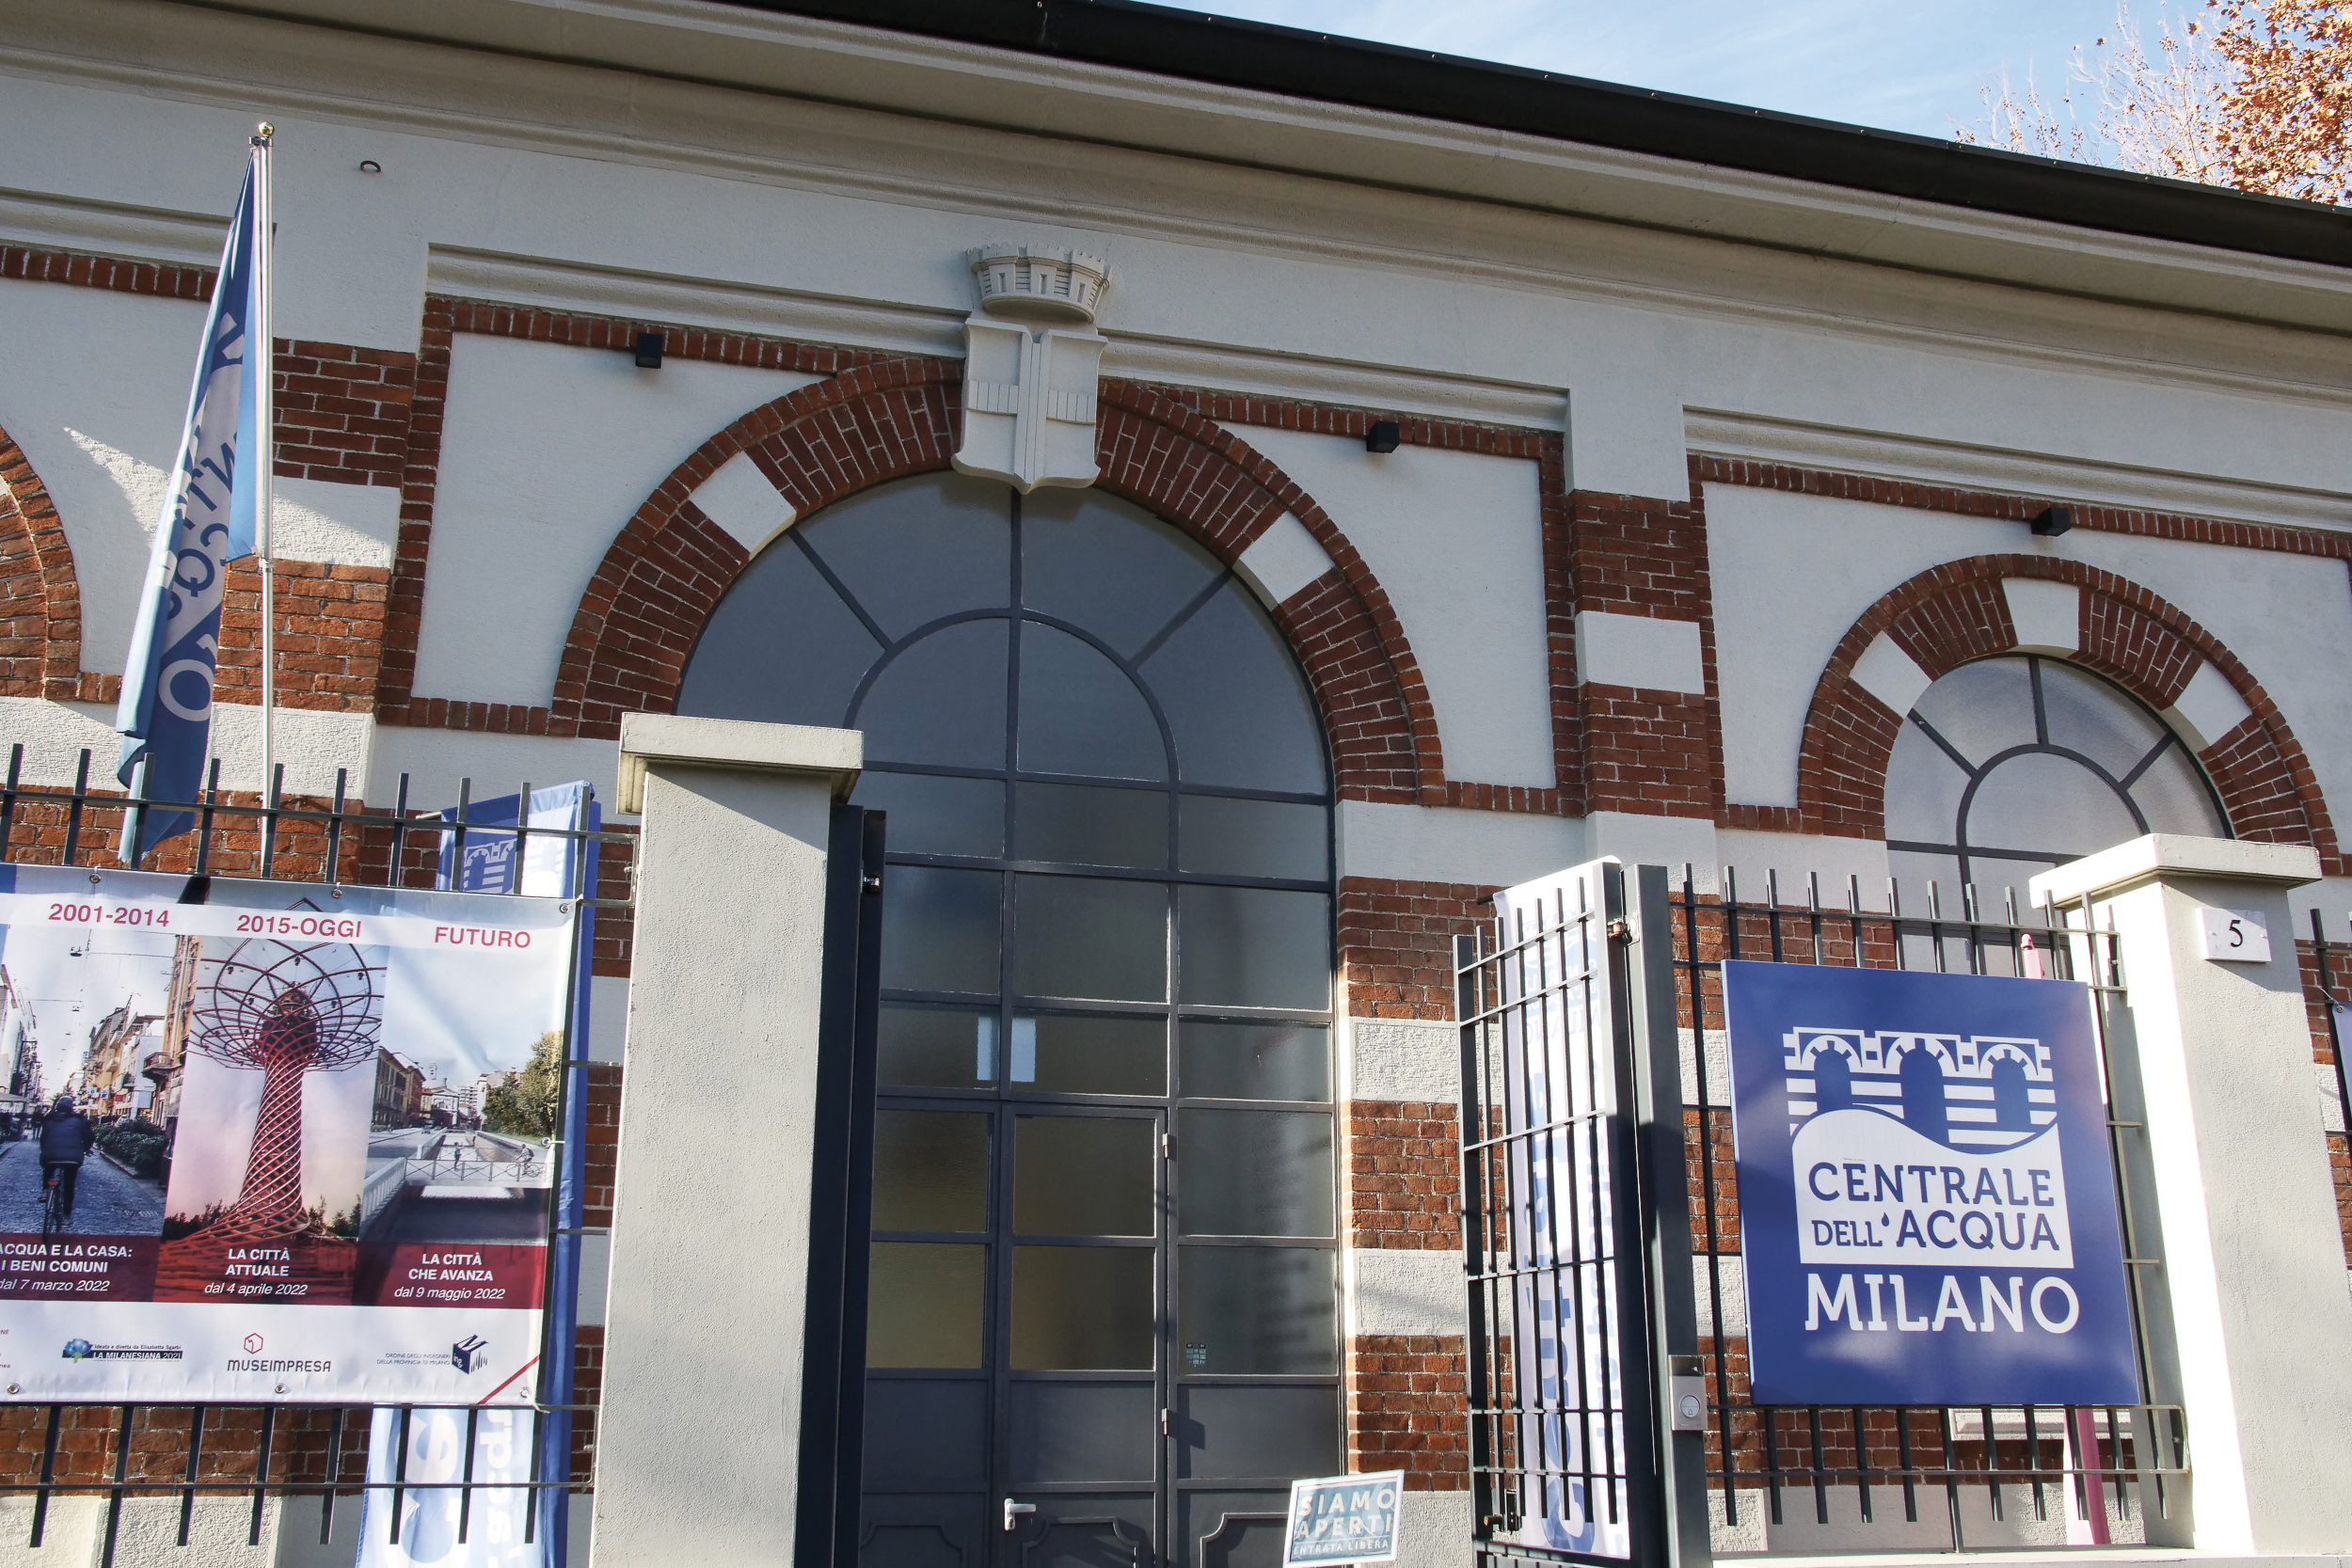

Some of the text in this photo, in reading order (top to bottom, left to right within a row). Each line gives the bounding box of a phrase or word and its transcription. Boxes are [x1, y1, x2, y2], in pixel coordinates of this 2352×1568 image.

[48, 903, 169, 927] 2001-2014
[236, 914, 361, 938] 2015-OGGI
[2229, 919, 2244, 948] 5
[435, 927, 532, 949] FUTURO
[1808, 1162, 2055, 1207] CENTRALE
[51, 1244, 61, 1256] E
[64, 1245, 84, 1257] LA
[87, 1245, 133, 1258] CASA:
[228, 1247, 291, 1260] LA CITTÀ
[1, 1260, 108, 1273] I BENI COMUNI
[421, 1252, 483, 1266] LA CITTÀ
[225, 1264, 290, 1276] ATTUALE
[408, 1269, 494, 1281] CHE AVANZA
[20, 1279, 30, 1290] 7
[32, 1281, 73, 1291] marzo
[75, 1280, 110, 1291] 2022
[204, 1282, 309, 1297] dal 4 aprile 2022
[394, 1286, 506, 1301] dal 9 maggio 2022
[1804, 1272, 2080, 1335] MILANO
[227, 1359, 332, 1372] MUSEIMPRESA
[1299, 1488, 1396, 1516] SIAMO
[1295, 1513, 1392, 1540] APERTI
[1294, 1539, 1390, 1555] ENTRATA LIBERA
